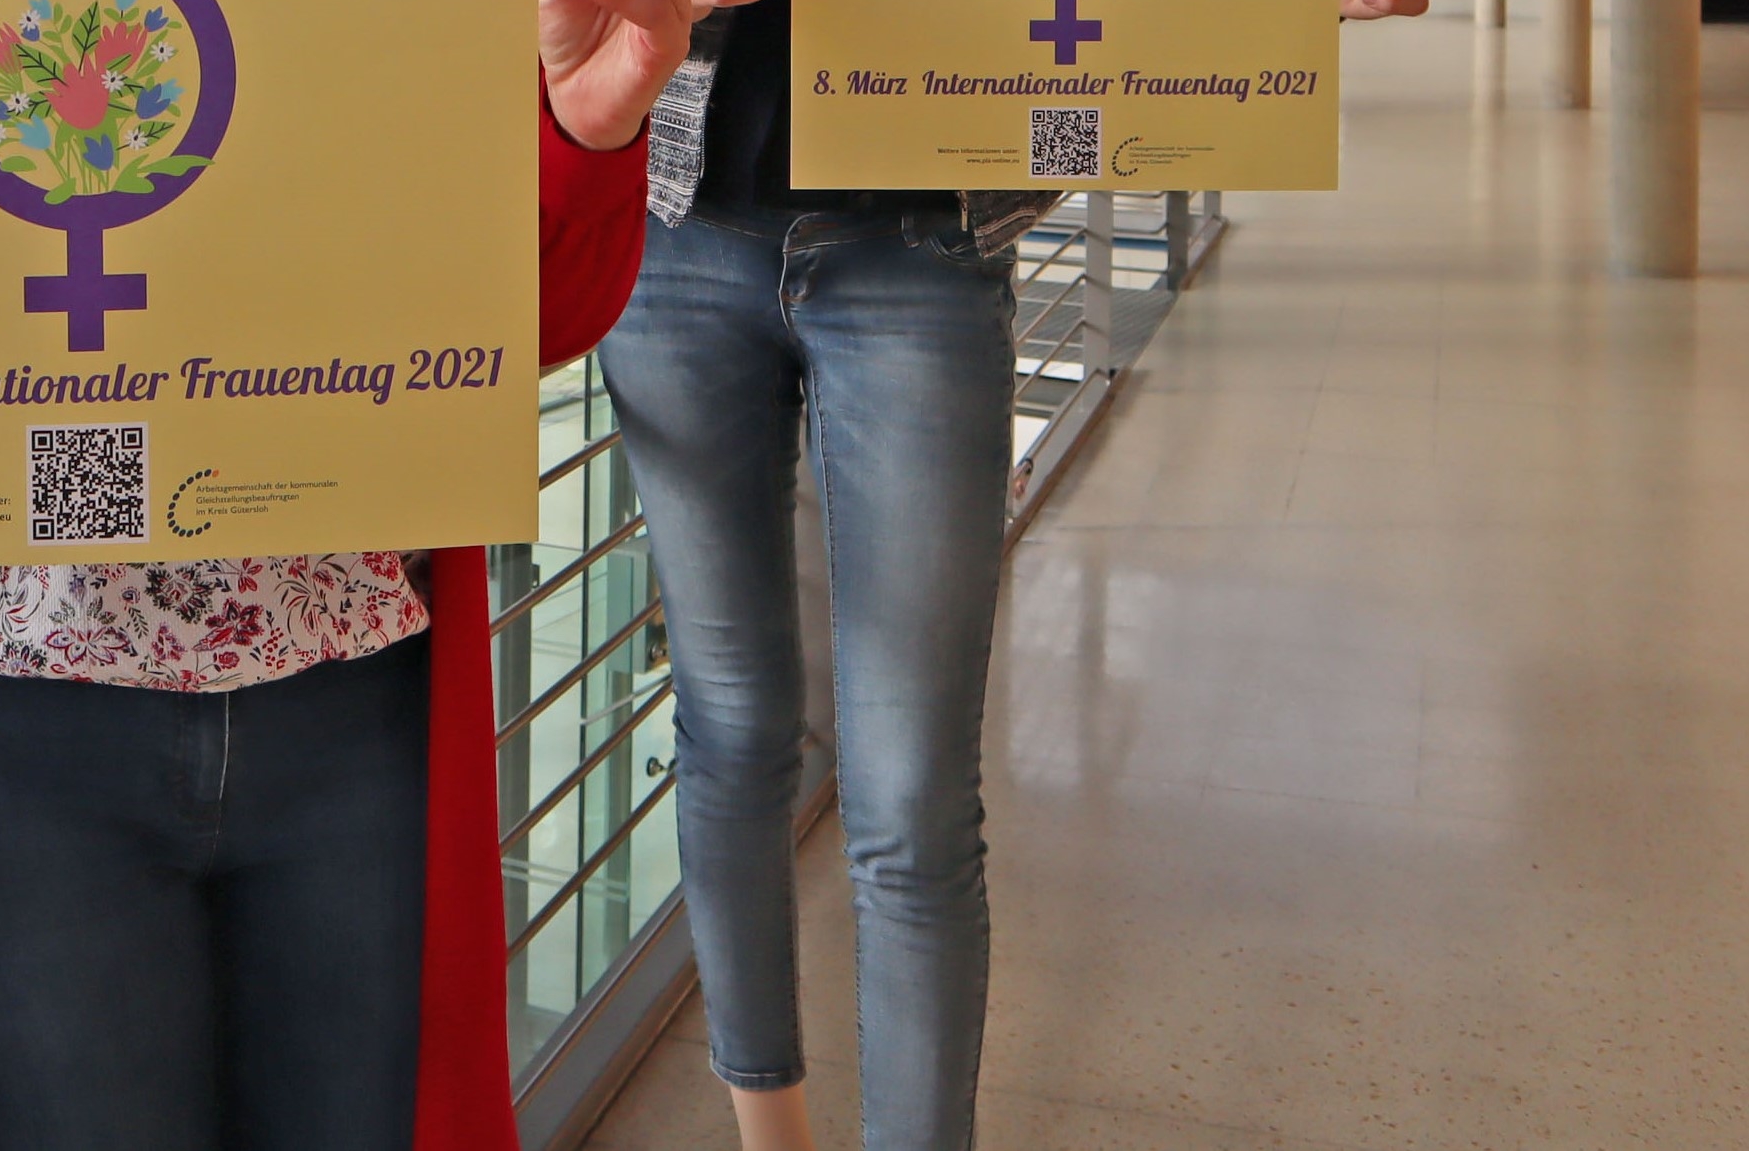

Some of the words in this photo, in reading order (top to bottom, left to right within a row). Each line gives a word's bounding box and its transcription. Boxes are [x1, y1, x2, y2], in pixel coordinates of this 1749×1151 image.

[813, 69, 837, 96] 8.
[846, 70, 908, 96] März
[921, 69, 1115, 96] Internationaler
[1120, 70, 1251, 103] Frauentag
[1256, 70, 1318, 96] 2021
[180, 357, 396, 406] Frauentag
[405, 346, 504, 391] 2021
[196, 483, 272, 494] Arbeitsgemeinschaft
[274, 481, 288, 490] der
[289, 479, 339, 489] kommunalen
[195, 493, 300, 505] Gleichstellungsbeauftragten
[195, 508, 206, 516] im
[207, 506, 228, 515] Kreis
[230, 504, 269, 514] Gütersloh
